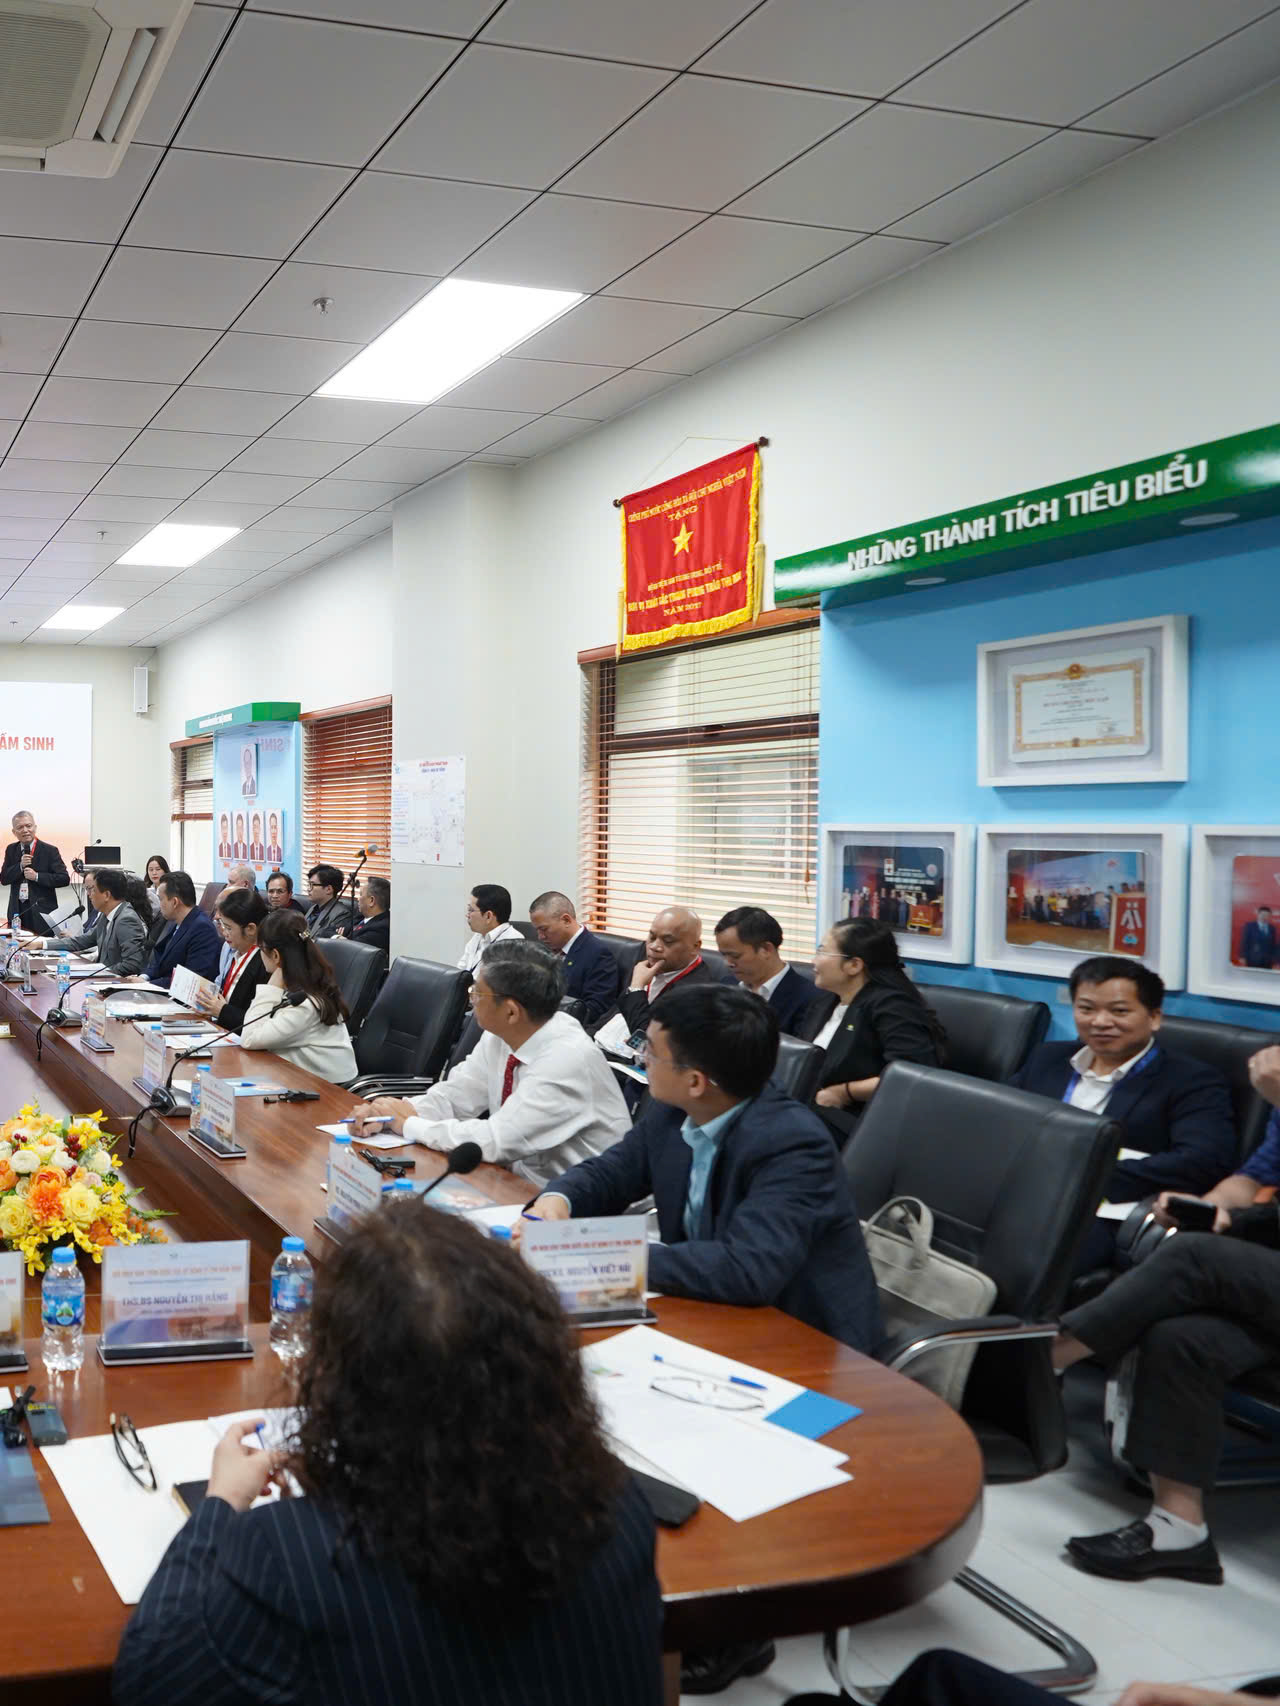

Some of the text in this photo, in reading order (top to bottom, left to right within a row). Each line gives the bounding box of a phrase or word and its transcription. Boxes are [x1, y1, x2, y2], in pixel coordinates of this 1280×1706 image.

[847, 453, 1208, 571] NHỮNG THÀNH TÍCH TIÊU BIỂU
[23, 736, 55, 751] SINH
